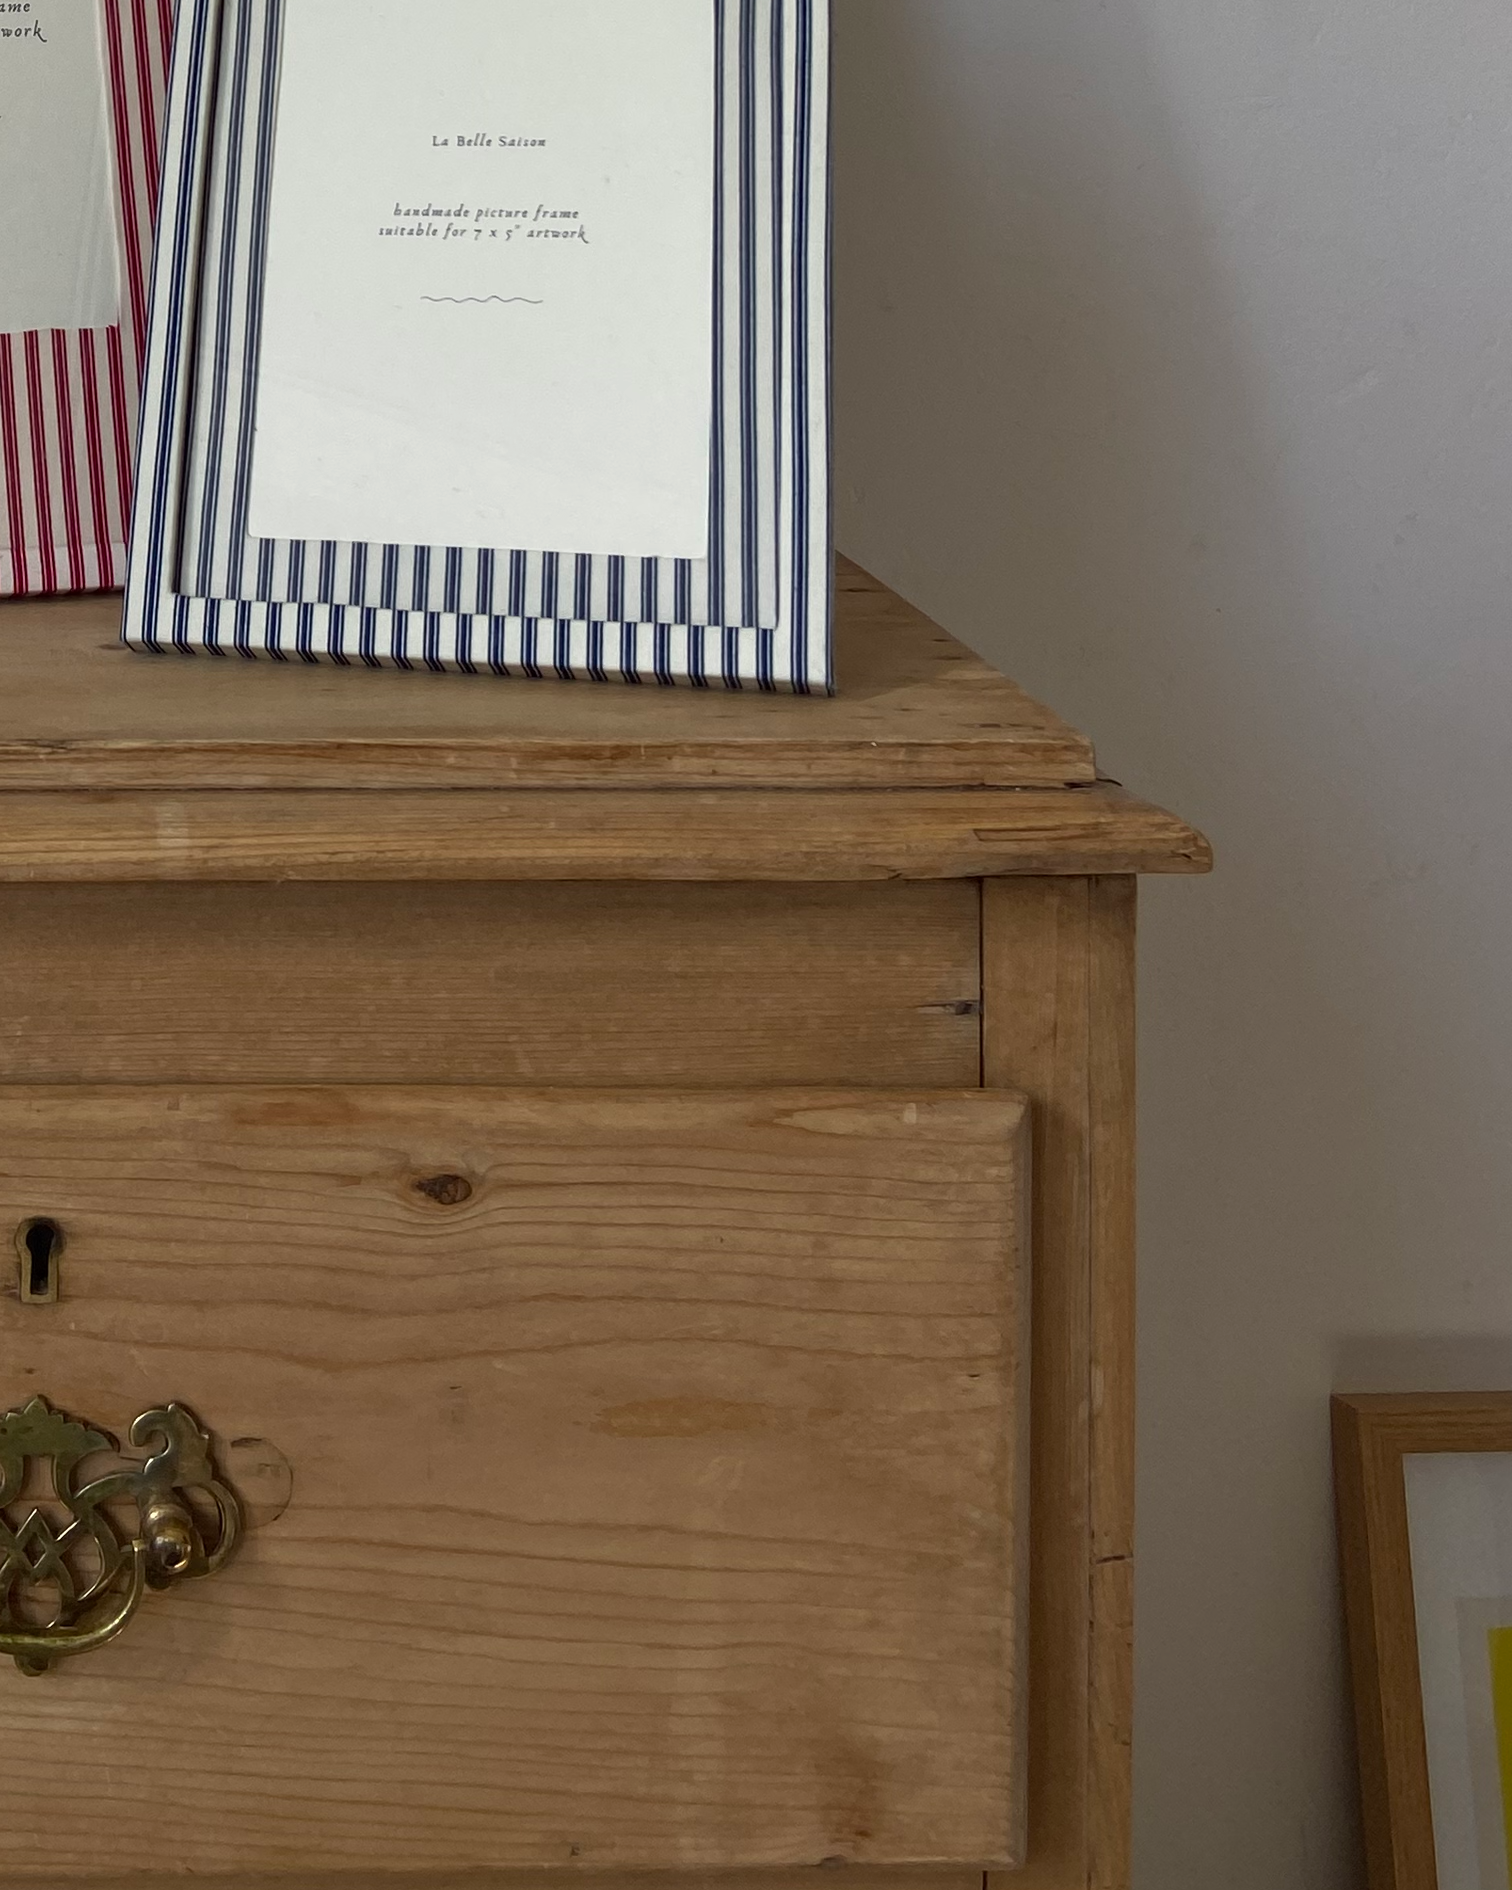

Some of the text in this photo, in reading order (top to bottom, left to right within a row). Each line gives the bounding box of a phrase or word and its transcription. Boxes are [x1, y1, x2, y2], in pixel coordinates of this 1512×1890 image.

[431, 132, 547, 148] La Belle Saison
[393, 202, 580, 223] handmade picture frame
[378, 221, 439, 238] suitable
[442, 221, 468, 241] for
[473, 228, 483, 241] 7
[488, 228, 498, 239] x
[526, 224, 590, 245] artwork
